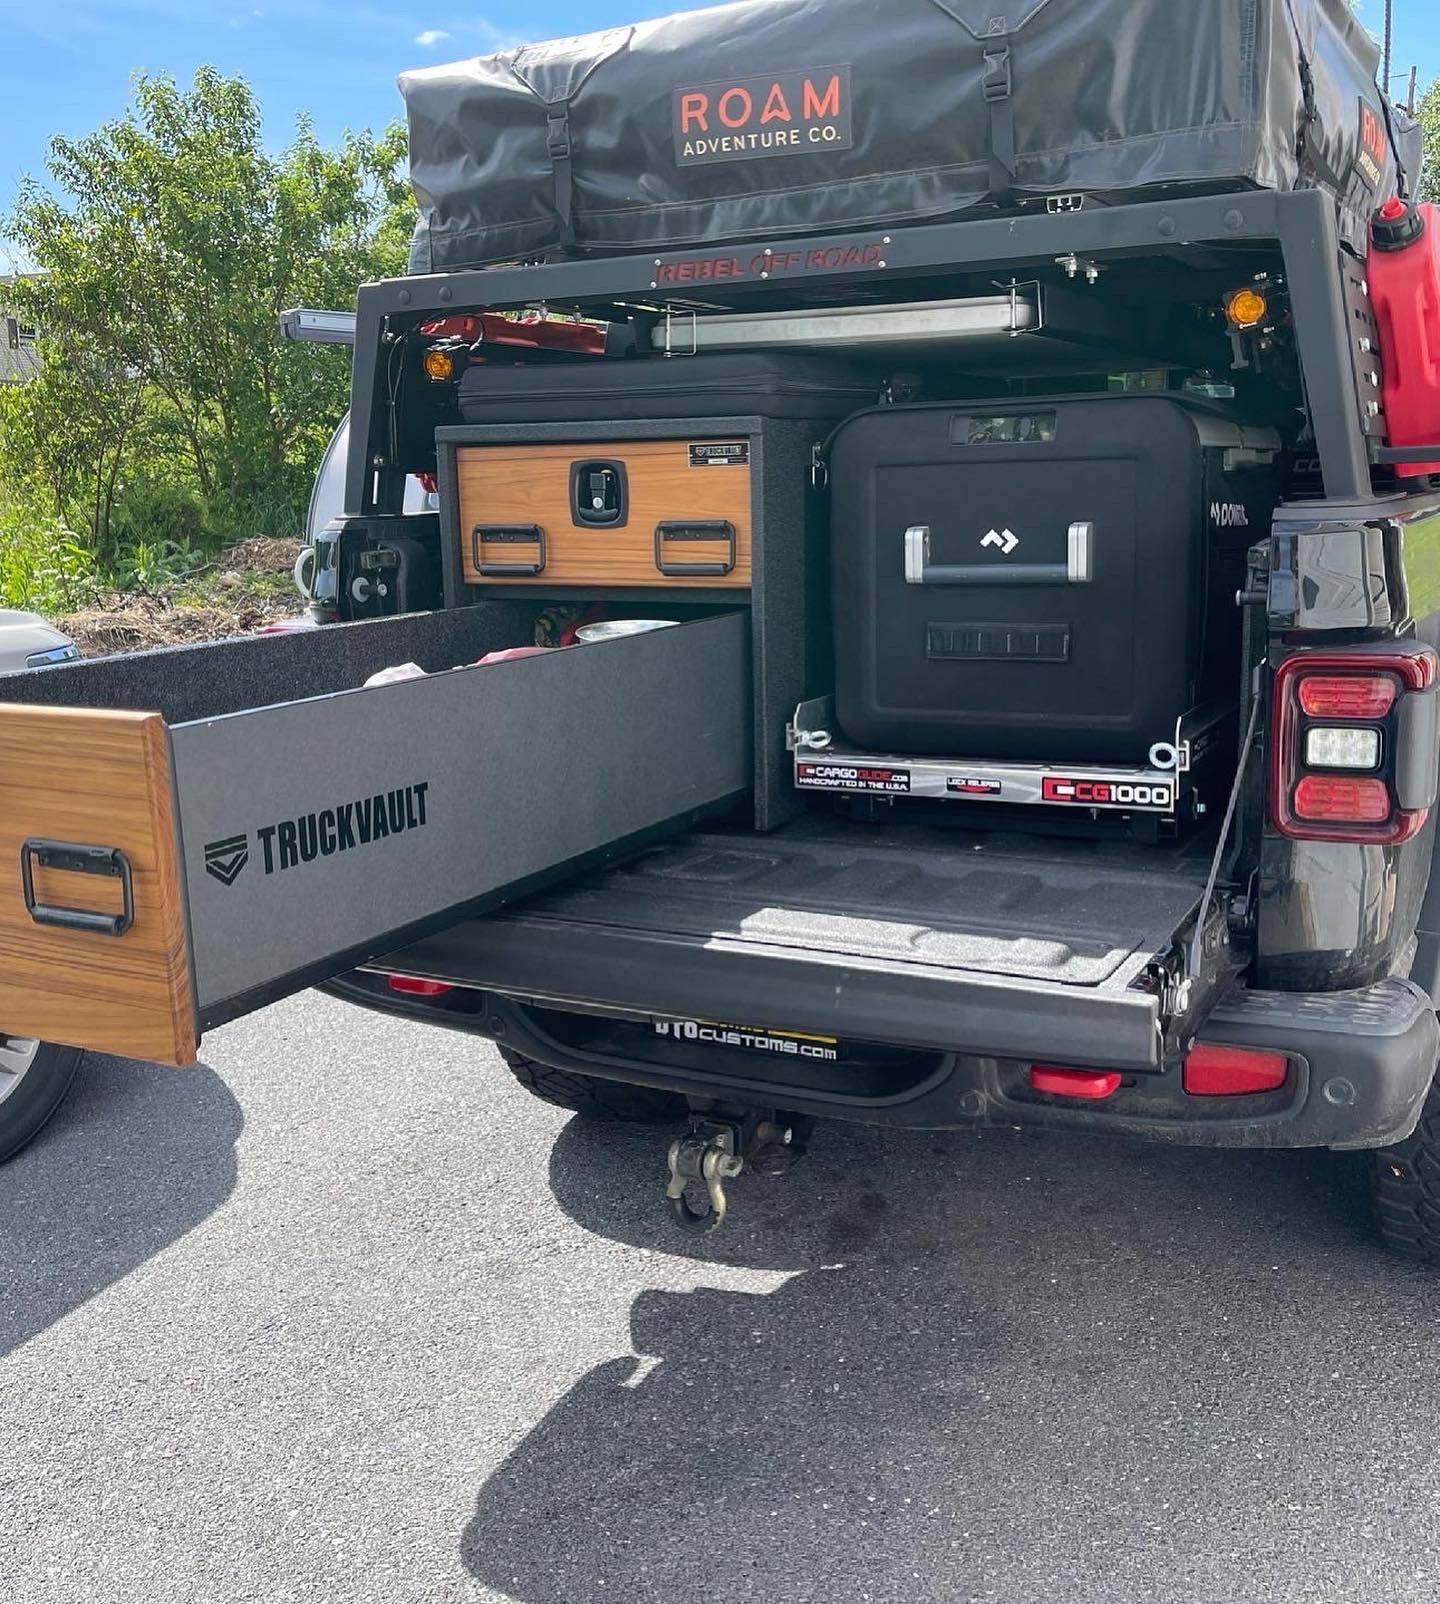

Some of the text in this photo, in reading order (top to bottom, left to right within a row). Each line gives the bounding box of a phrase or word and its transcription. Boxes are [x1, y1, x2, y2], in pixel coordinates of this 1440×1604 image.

[680, 74, 840, 134] ROAM
[683, 125, 842, 157] ADVENTURE CO.
[655, 243, 882, 283] REBEL OFF ROAD
[799, 777, 858, 788] HANDCRAFTED
[858, 780, 867, 788] IN
[868, 781, 885, 790] THE
[1075, 782, 1170, 804] CG1000
[256, 781, 429, 875] TRUCKVAULT
